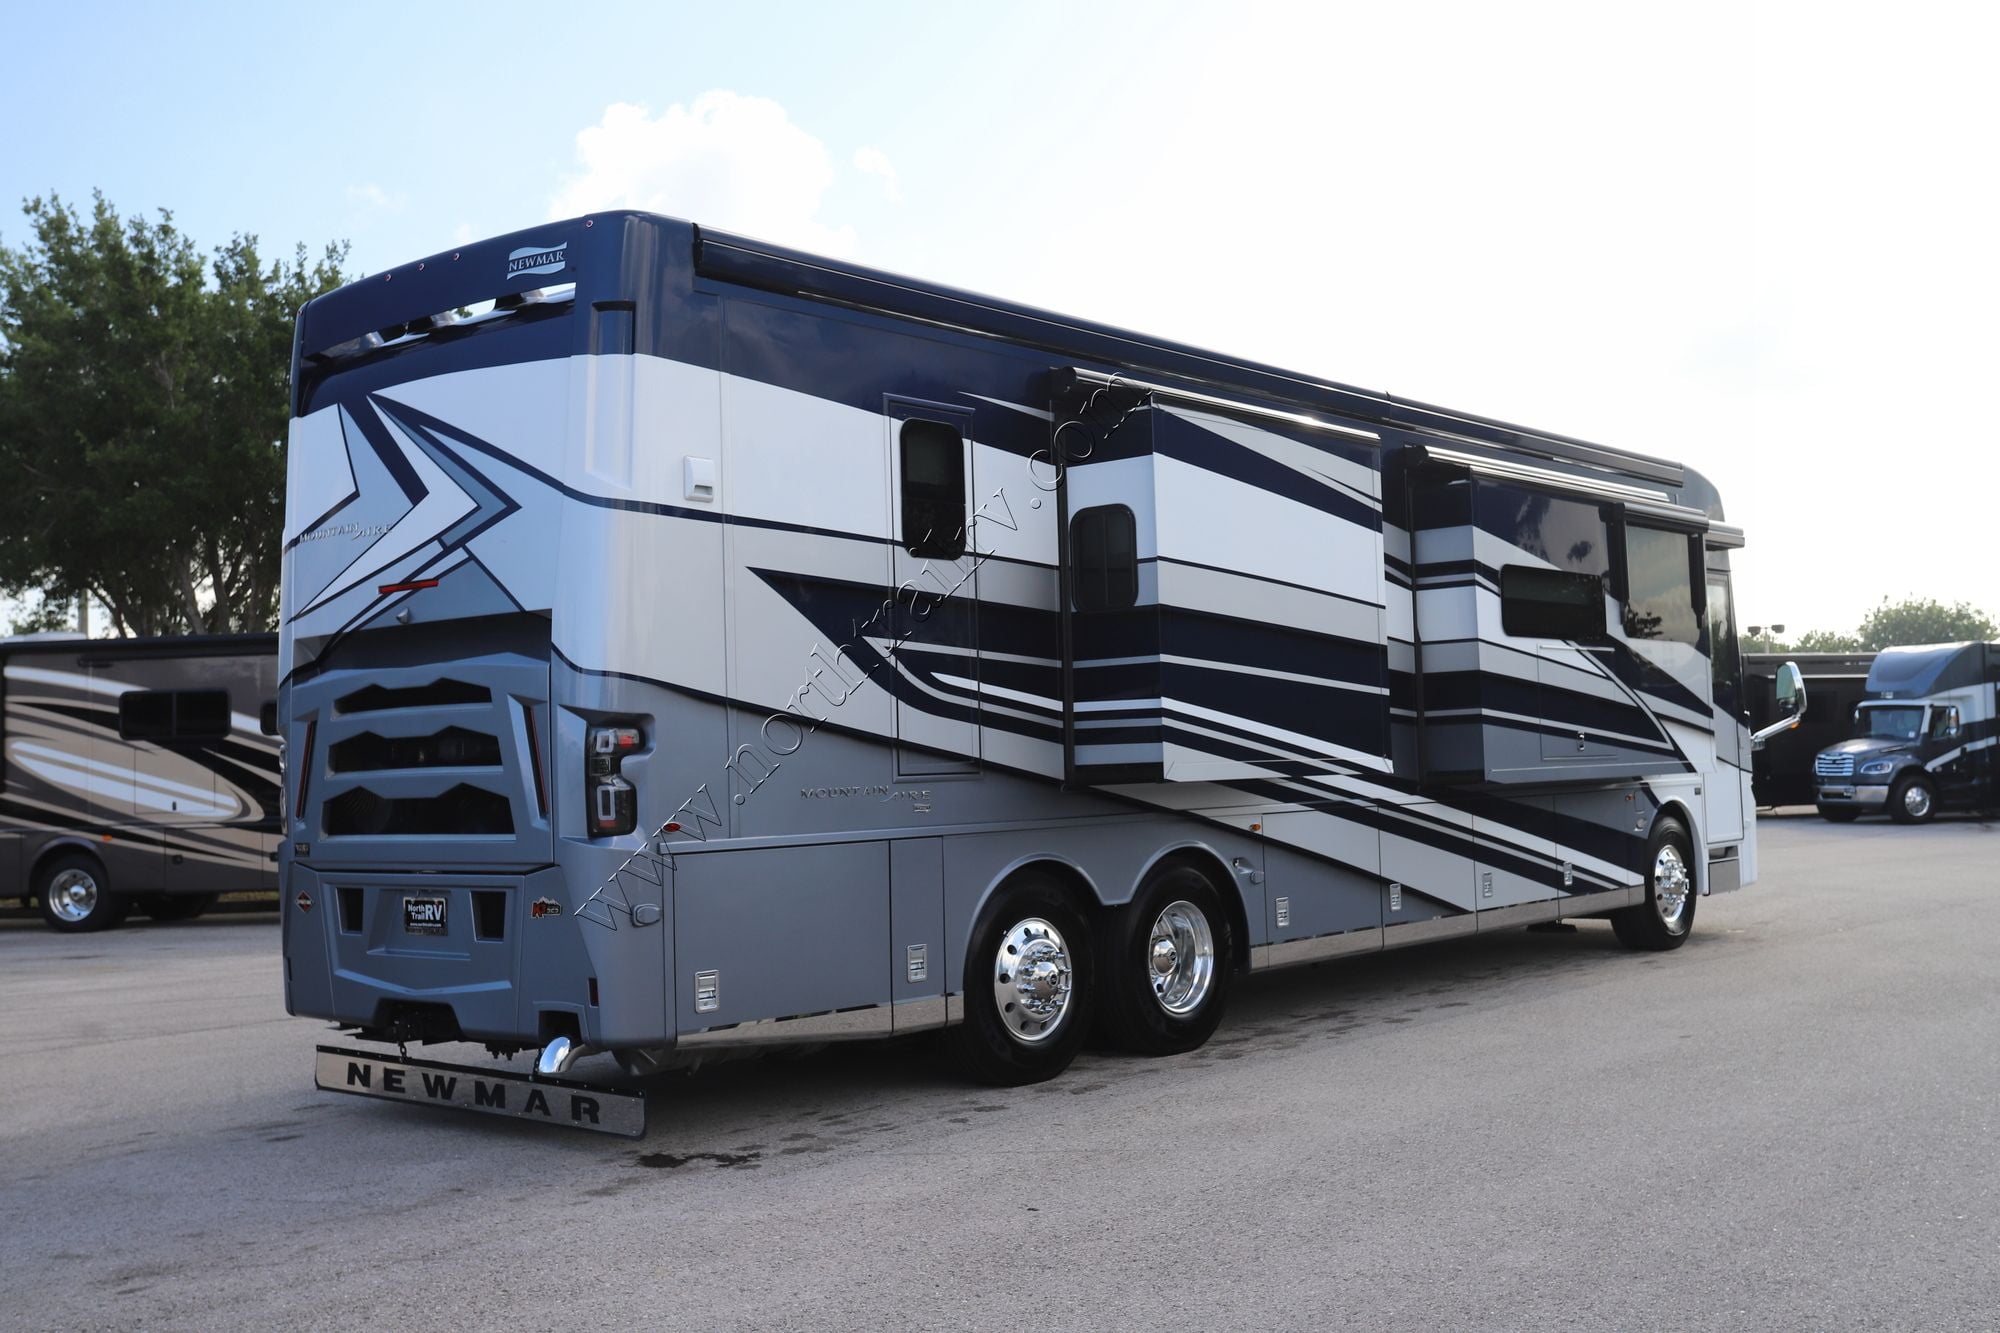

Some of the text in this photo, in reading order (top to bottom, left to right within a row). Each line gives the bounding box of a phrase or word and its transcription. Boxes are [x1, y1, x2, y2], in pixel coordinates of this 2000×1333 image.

[508, 251, 564, 272] NEWMAR
[800, 785, 889, 800] MOUNTAIN
[424, 904, 443, 921] RV
[346, 1061, 601, 1124] NEWMAR
